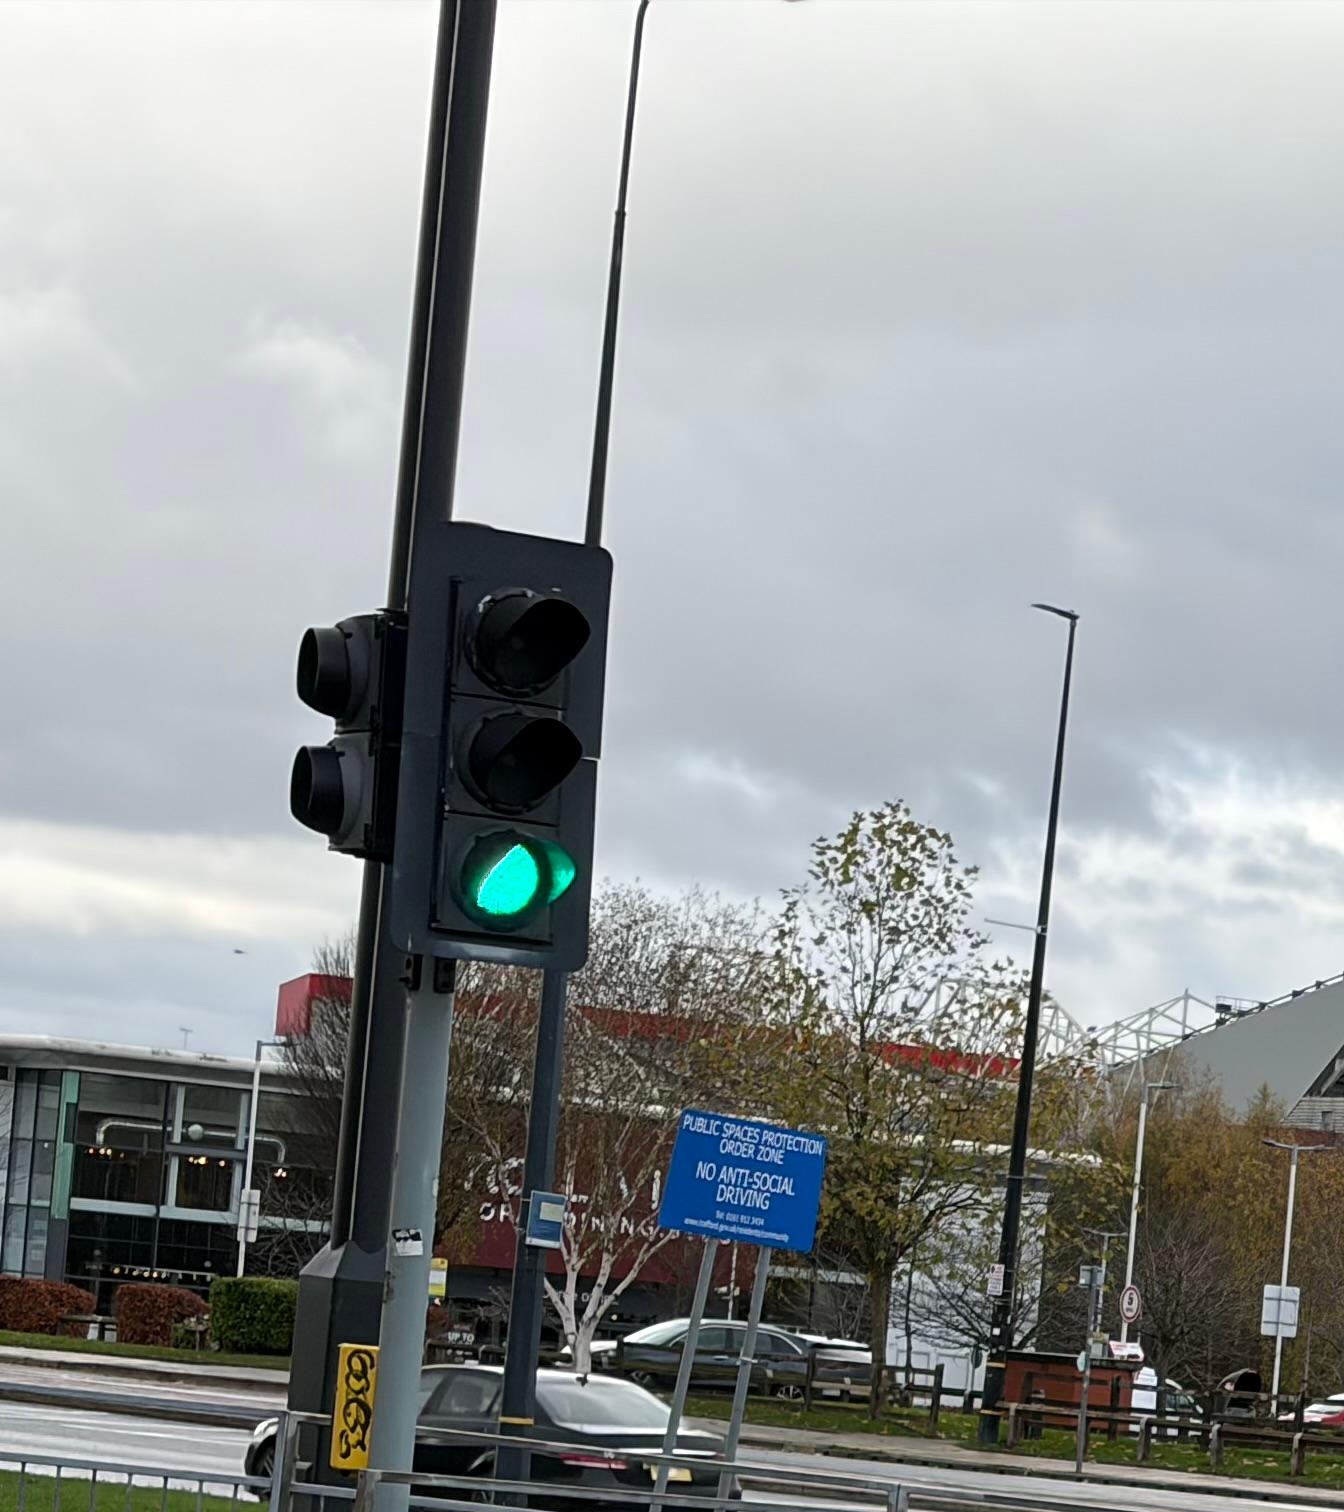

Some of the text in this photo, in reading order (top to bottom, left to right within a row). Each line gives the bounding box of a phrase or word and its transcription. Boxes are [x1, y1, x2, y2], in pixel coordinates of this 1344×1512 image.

[682, 1114, 823, 1155] PUBLIC SPACES PROTECTION
[719, 1139, 786, 1164] ORDER ZONE
[696, 1161, 795, 1196] NO ANTI-SOCIAL
[716, 1185, 770, 1210] DRIVING
[1126, 1291, 1134, 1307] 5
